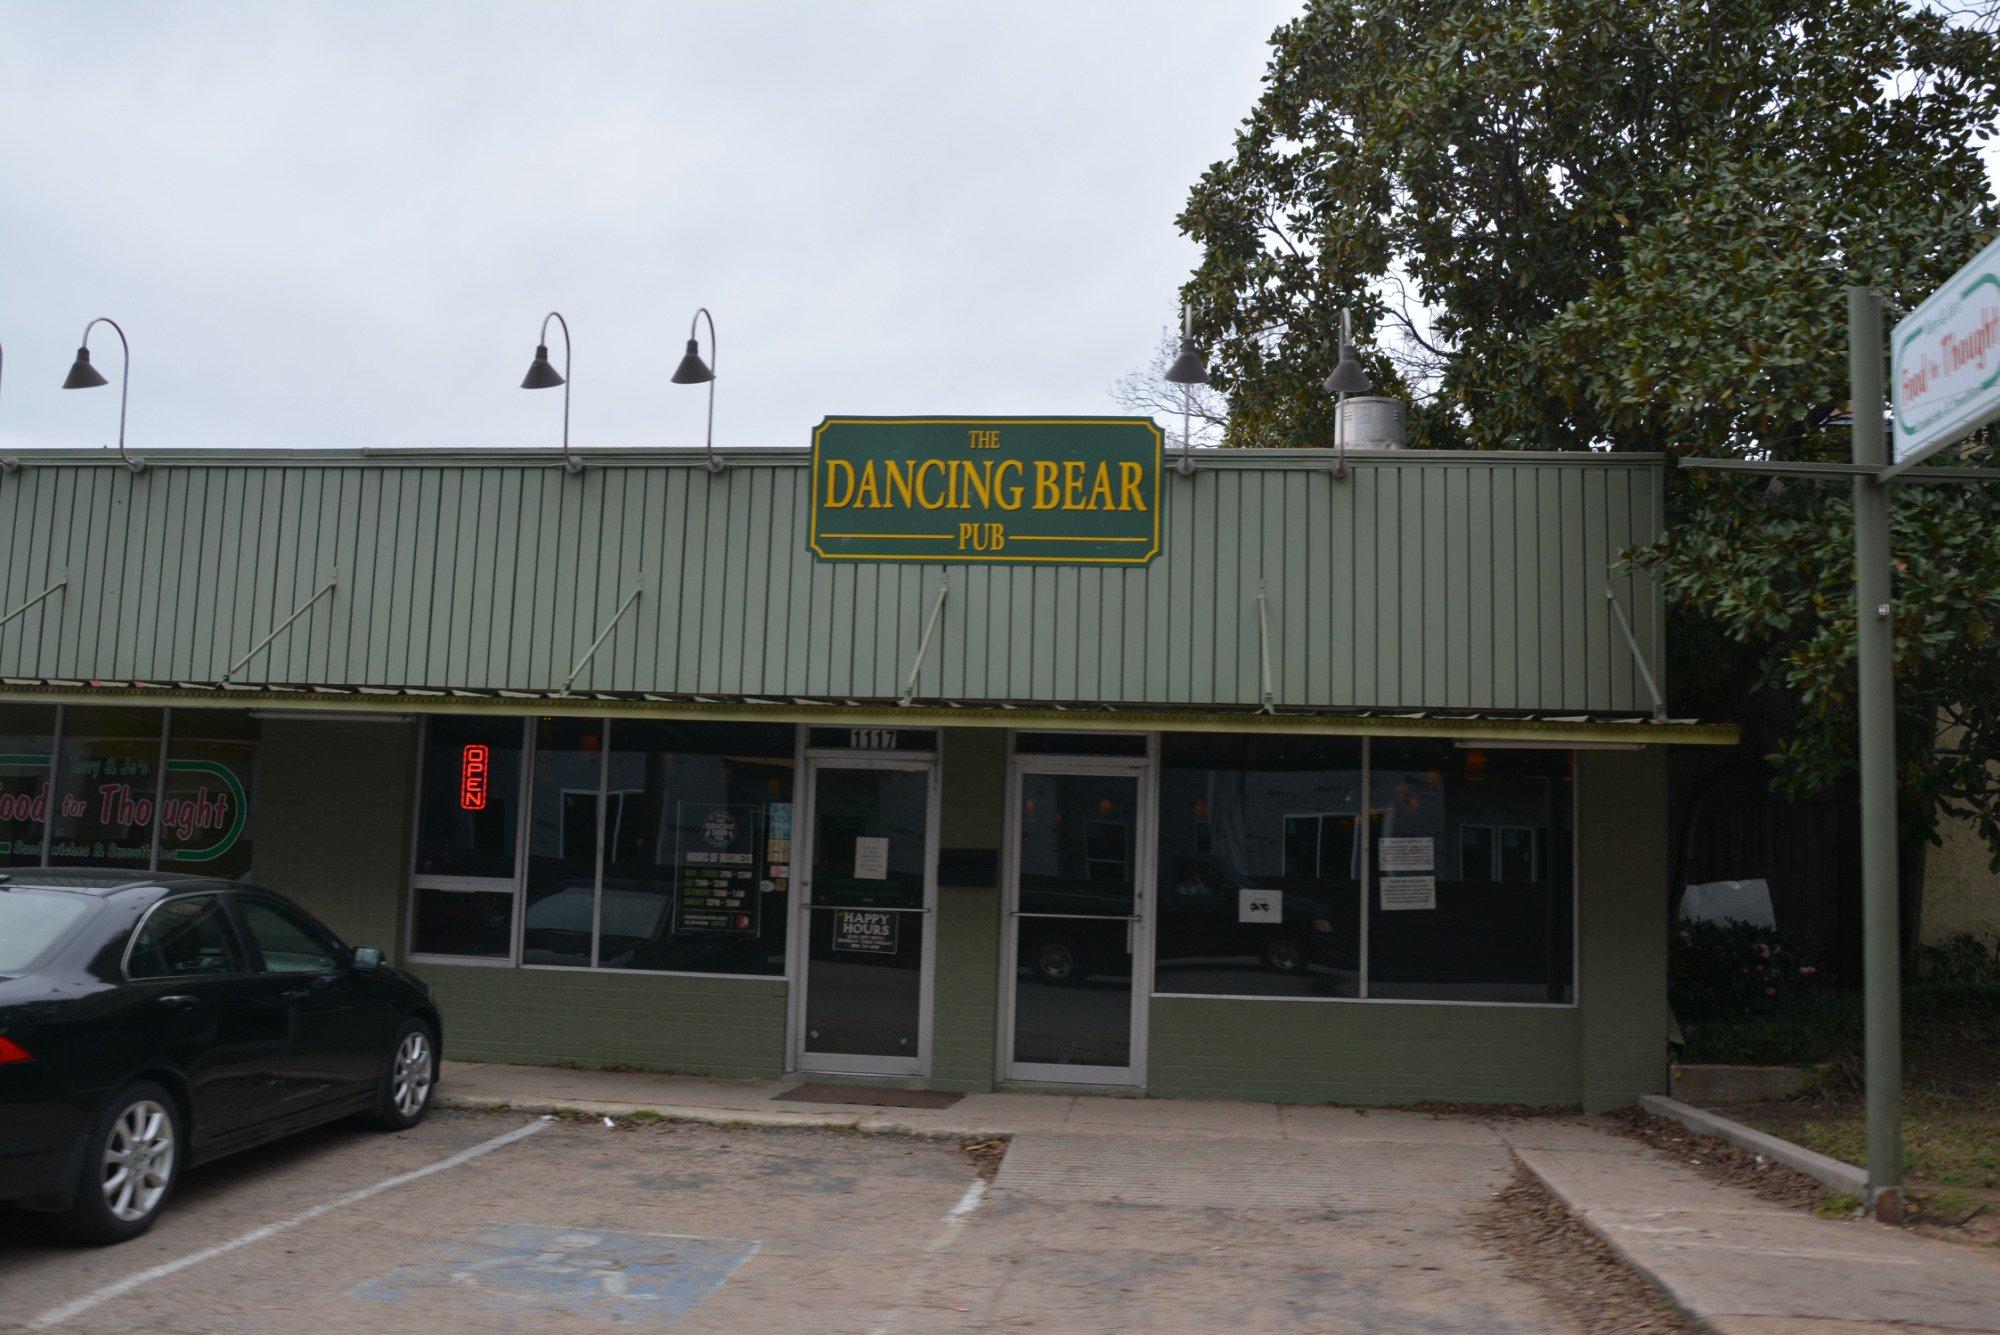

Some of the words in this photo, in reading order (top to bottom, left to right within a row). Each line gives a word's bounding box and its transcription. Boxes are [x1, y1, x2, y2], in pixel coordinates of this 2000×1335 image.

[968, 430, 1001, 449] THE
[824, 459, 1025, 511] DANCING
[1032, 460, 1148, 511] BEAR
[957, 523, 1006, 551] PUB
[854, 730, 894, 748] 1117
[465, 749, 484, 806] OPEN
[0, 781, 50, 823] ood
[62, 793, 88, 817] for
[100, 782, 228, 841] Thought
[842, 923, 890, 936] HOURS
[843, 912, 890, 926] HAPPY
